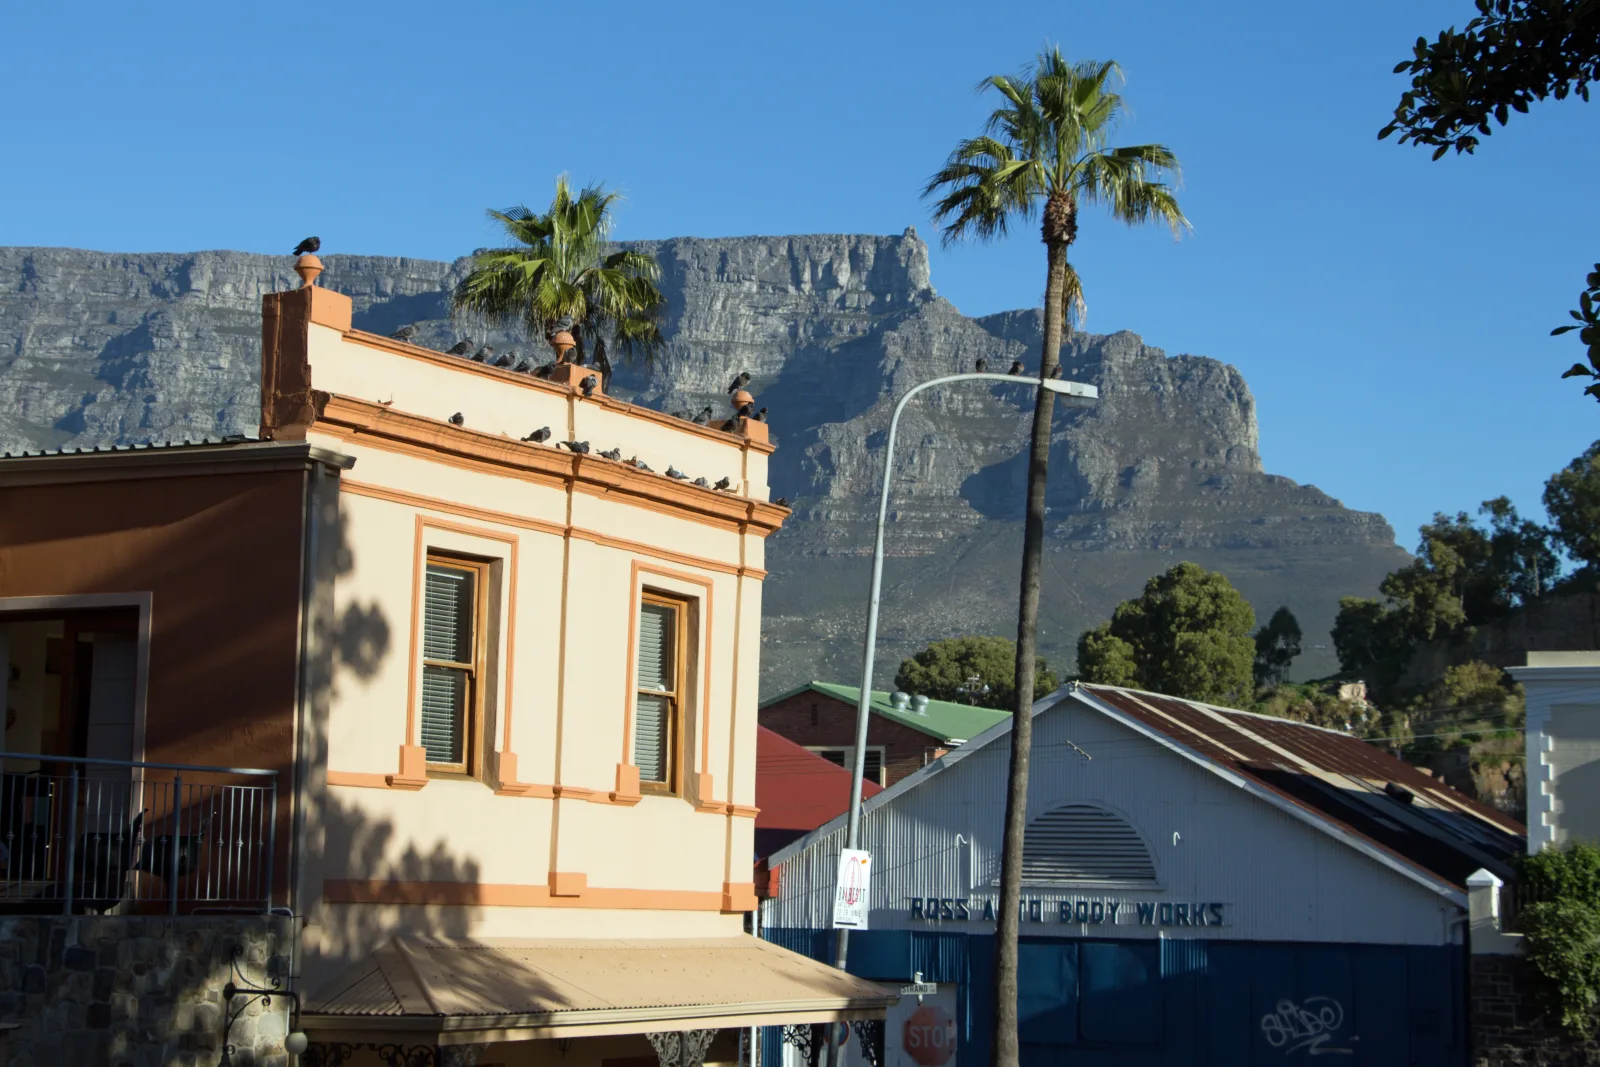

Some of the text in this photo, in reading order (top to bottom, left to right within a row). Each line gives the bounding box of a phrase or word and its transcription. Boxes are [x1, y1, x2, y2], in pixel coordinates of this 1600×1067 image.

[911, 898, 1224, 926] ROSS ATO BODY WORKS
[901, 984, 928, 993] STRAND
[909, 1026, 956, 1048] STOP
